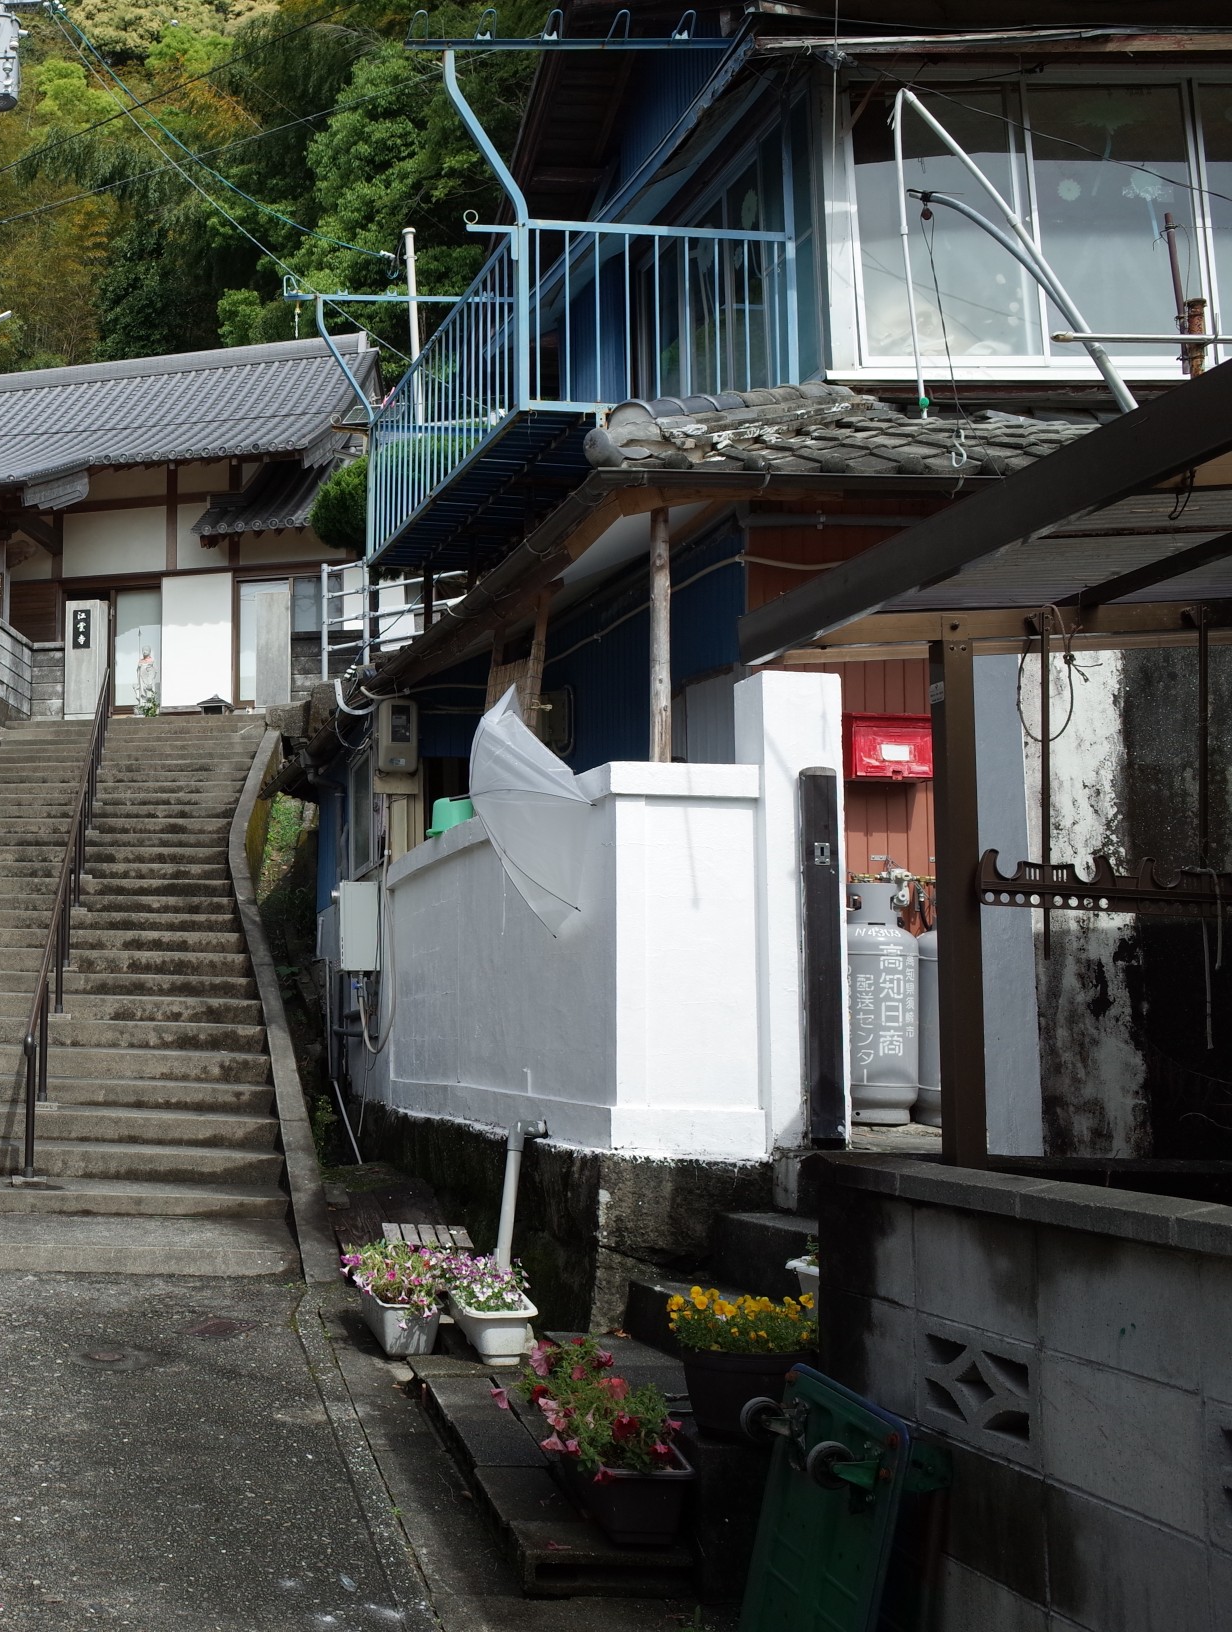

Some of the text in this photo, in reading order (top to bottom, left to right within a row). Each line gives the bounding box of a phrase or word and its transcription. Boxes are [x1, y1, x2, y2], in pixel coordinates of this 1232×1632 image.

[856, 974, 875, 1084] 配送センター
[879, 943, 904, 1057] 高知日商
